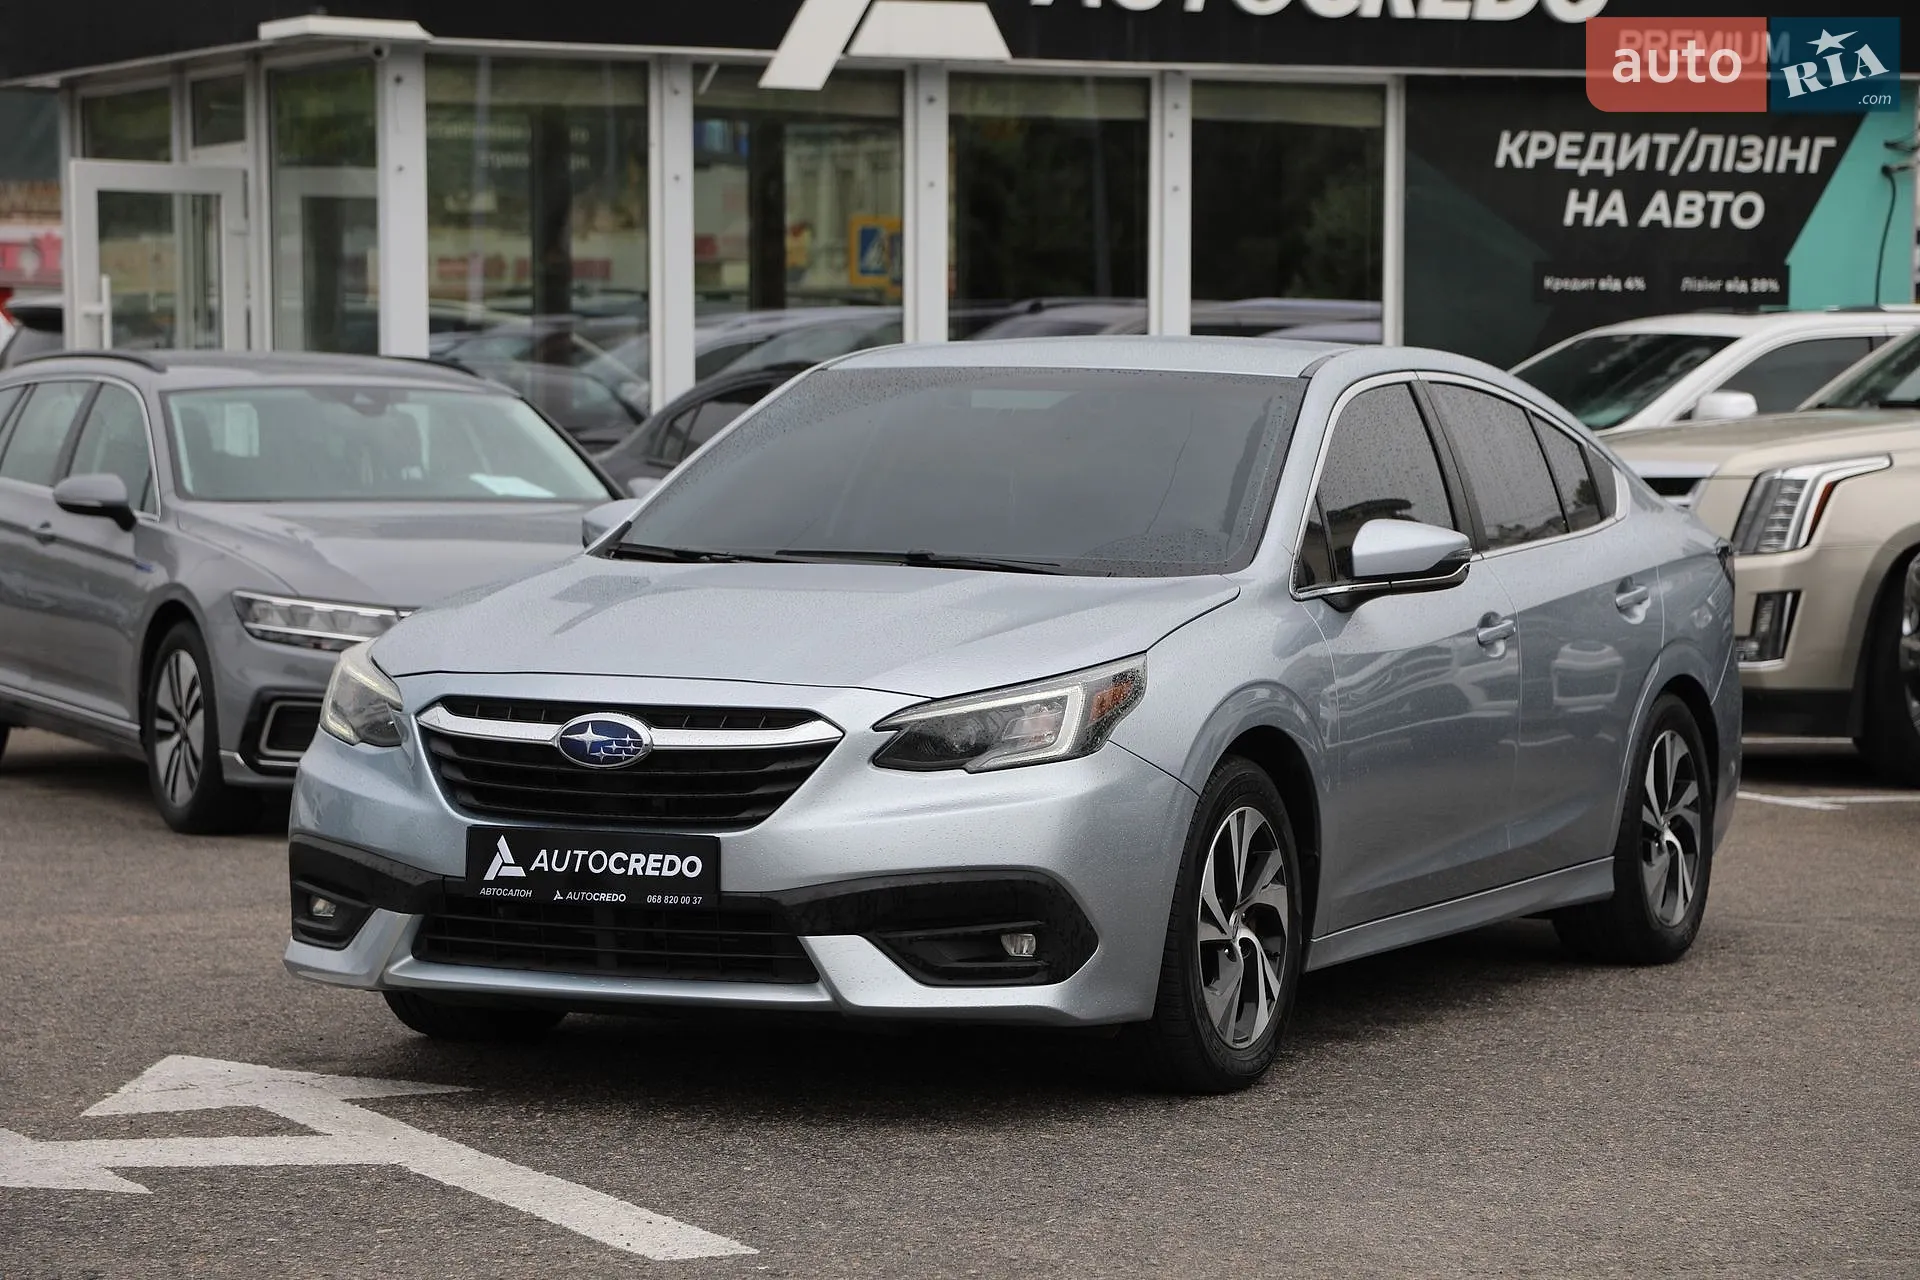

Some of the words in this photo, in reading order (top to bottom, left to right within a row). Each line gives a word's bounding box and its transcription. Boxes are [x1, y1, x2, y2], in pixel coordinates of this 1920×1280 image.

[1619, 29, 1790, 65] PREMIUM
[1495, 127, 1837, 177] КРЕДИТ/ЛІЗІНГ
[1562, 188, 1629, 227] НА
[1637, 189, 1766, 230] АВТО
[1544, 275, 1597, 292] Кредит
[1598, 274, 1622, 292] від
[1680, 275, 1723, 292] Лізінг
[1725, 275, 1749, 293] від
[529, 849, 703, 879] AUTOCREDO
[479, 887, 533, 898] АВТОСАЛОН
[565, 891, 627, 903] AUTOCREDO
[646, 894, 663, 904] 068
[663, 895, 679, 905] 820
[680, 895, 691, 905] 00
[691, 895, 703, 906] 37
